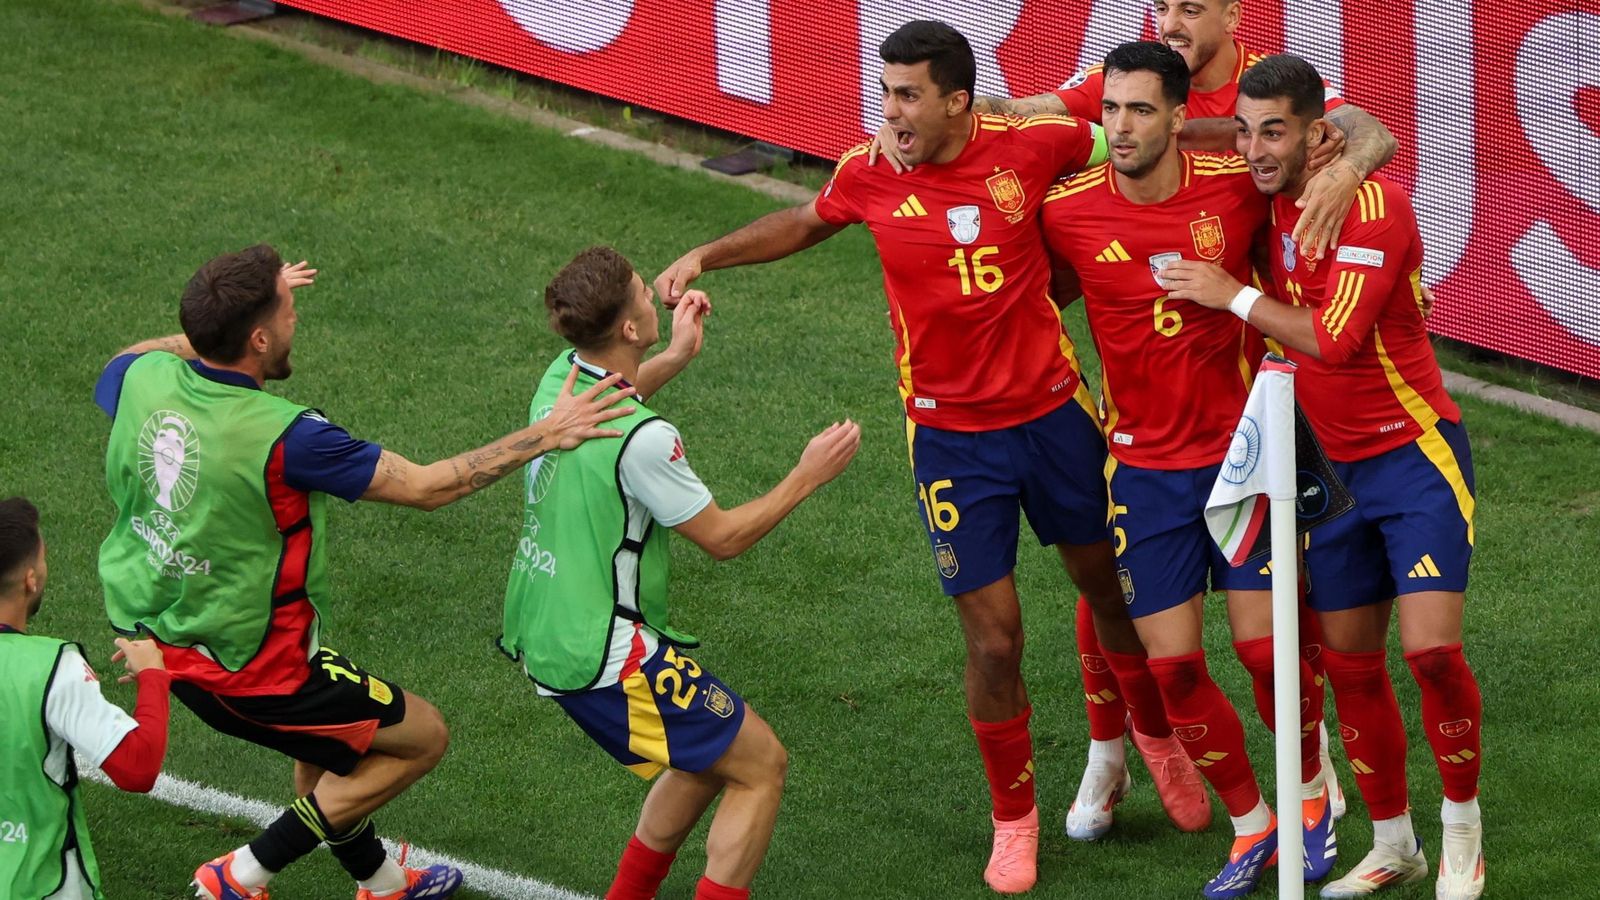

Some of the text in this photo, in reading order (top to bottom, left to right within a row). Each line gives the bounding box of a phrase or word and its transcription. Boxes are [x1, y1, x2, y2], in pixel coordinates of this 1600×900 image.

[948, 246, 1004, 295] 16
[1153, 294, 1183, 337] 6
[919, 479, 960, 533] 16
[655, 645, 702, 710] 25
[0, 820, 28, 844] 24
